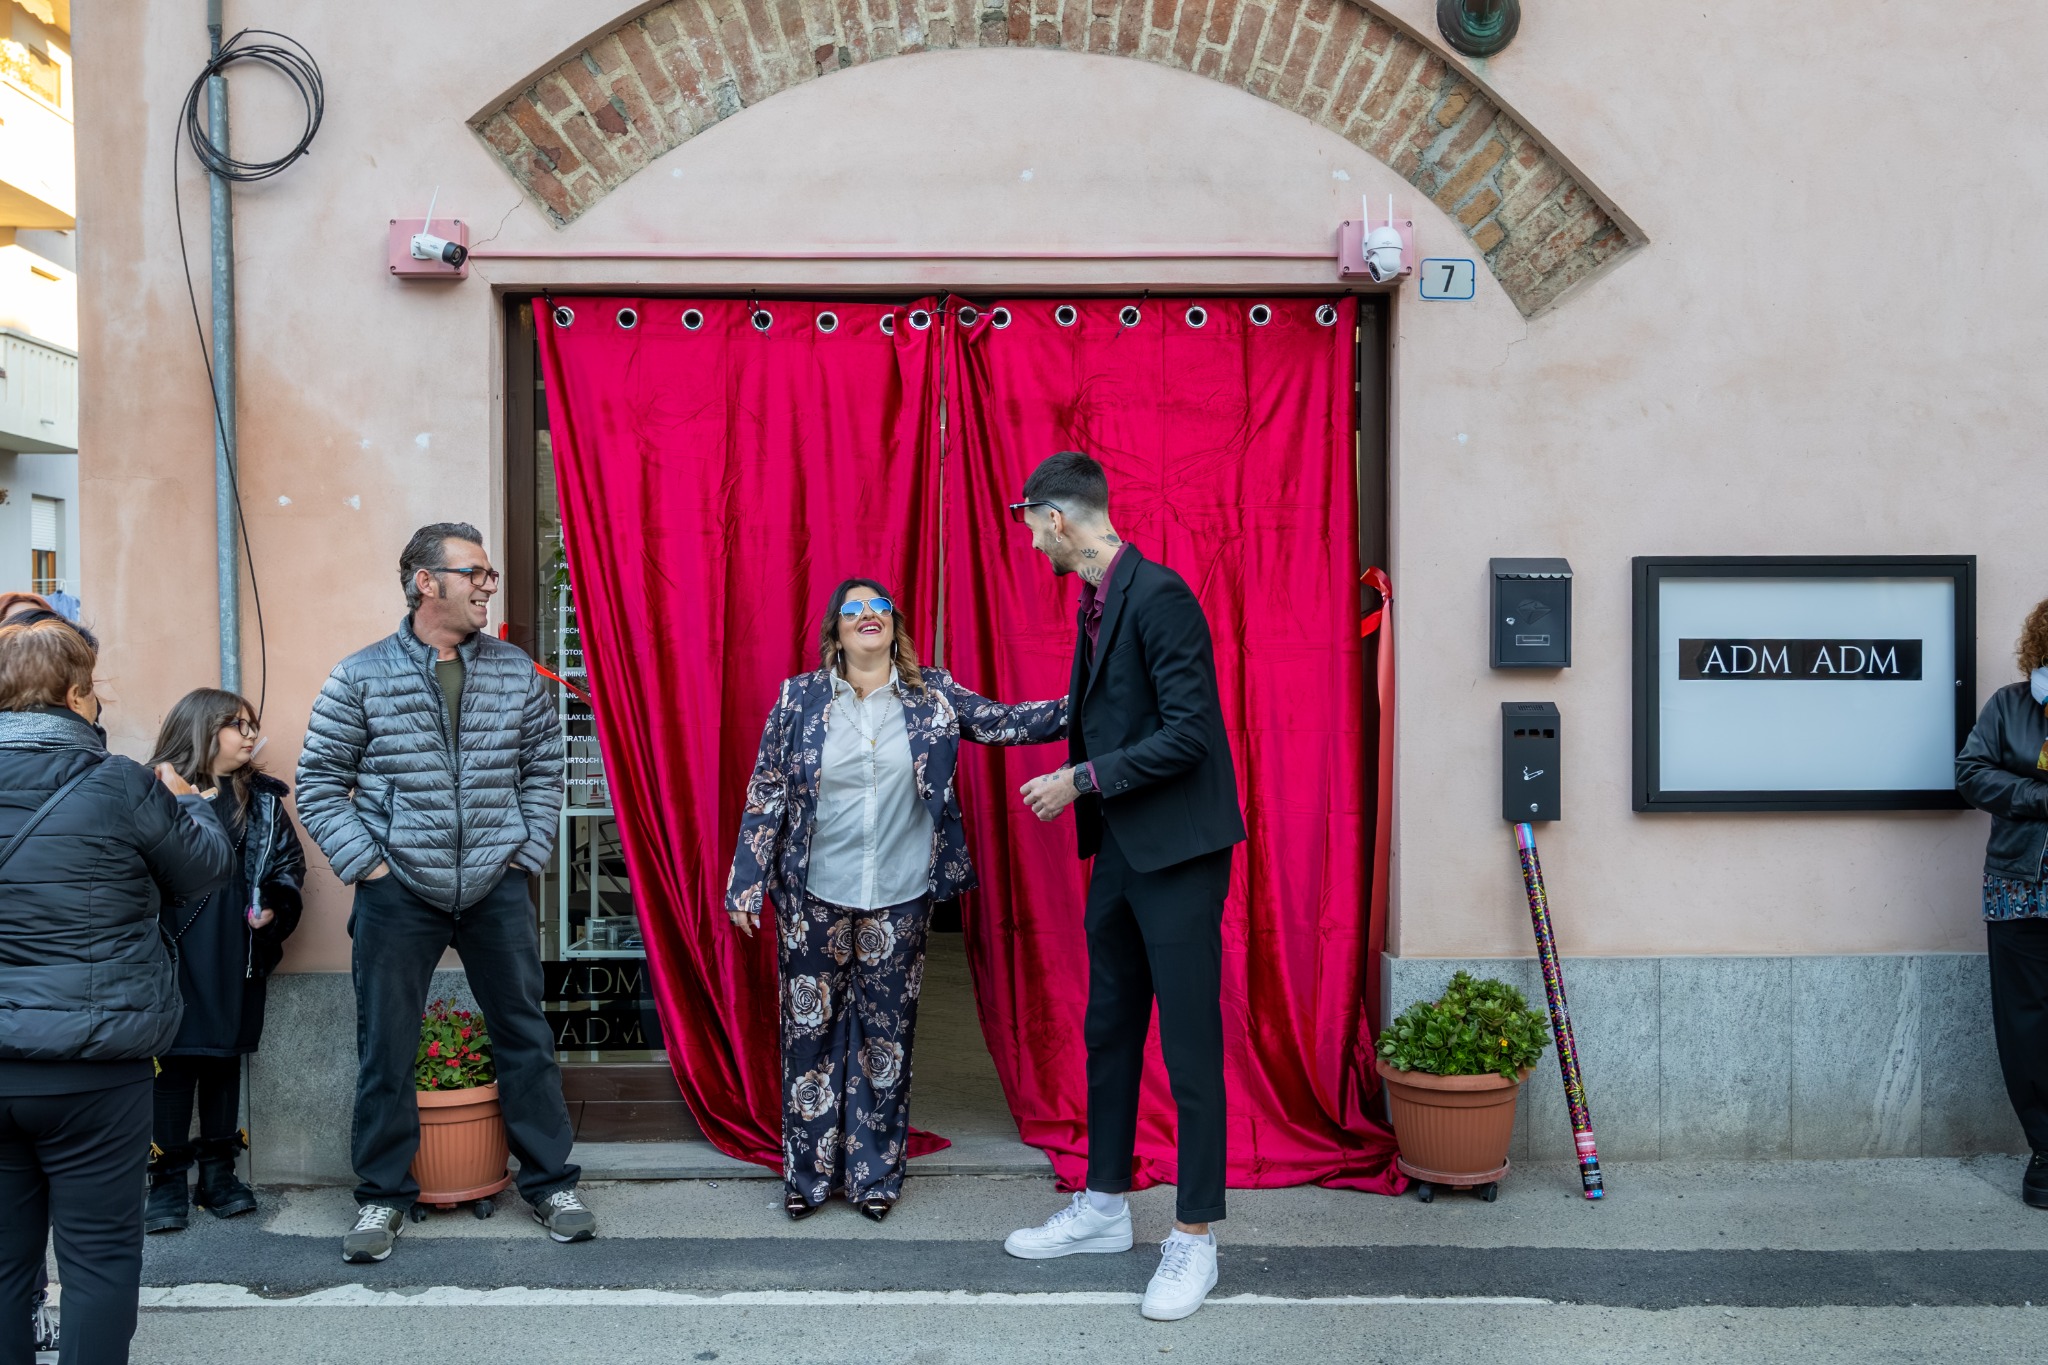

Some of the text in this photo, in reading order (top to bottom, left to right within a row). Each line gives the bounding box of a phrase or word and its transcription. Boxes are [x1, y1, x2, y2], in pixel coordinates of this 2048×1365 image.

[1441, 265, 1455, 293] 7
[1701, 645, 1901, 674] ADM ADM
[559, 966, 648, 995] ADM
[556, 1017, 645, 1045] ADM
